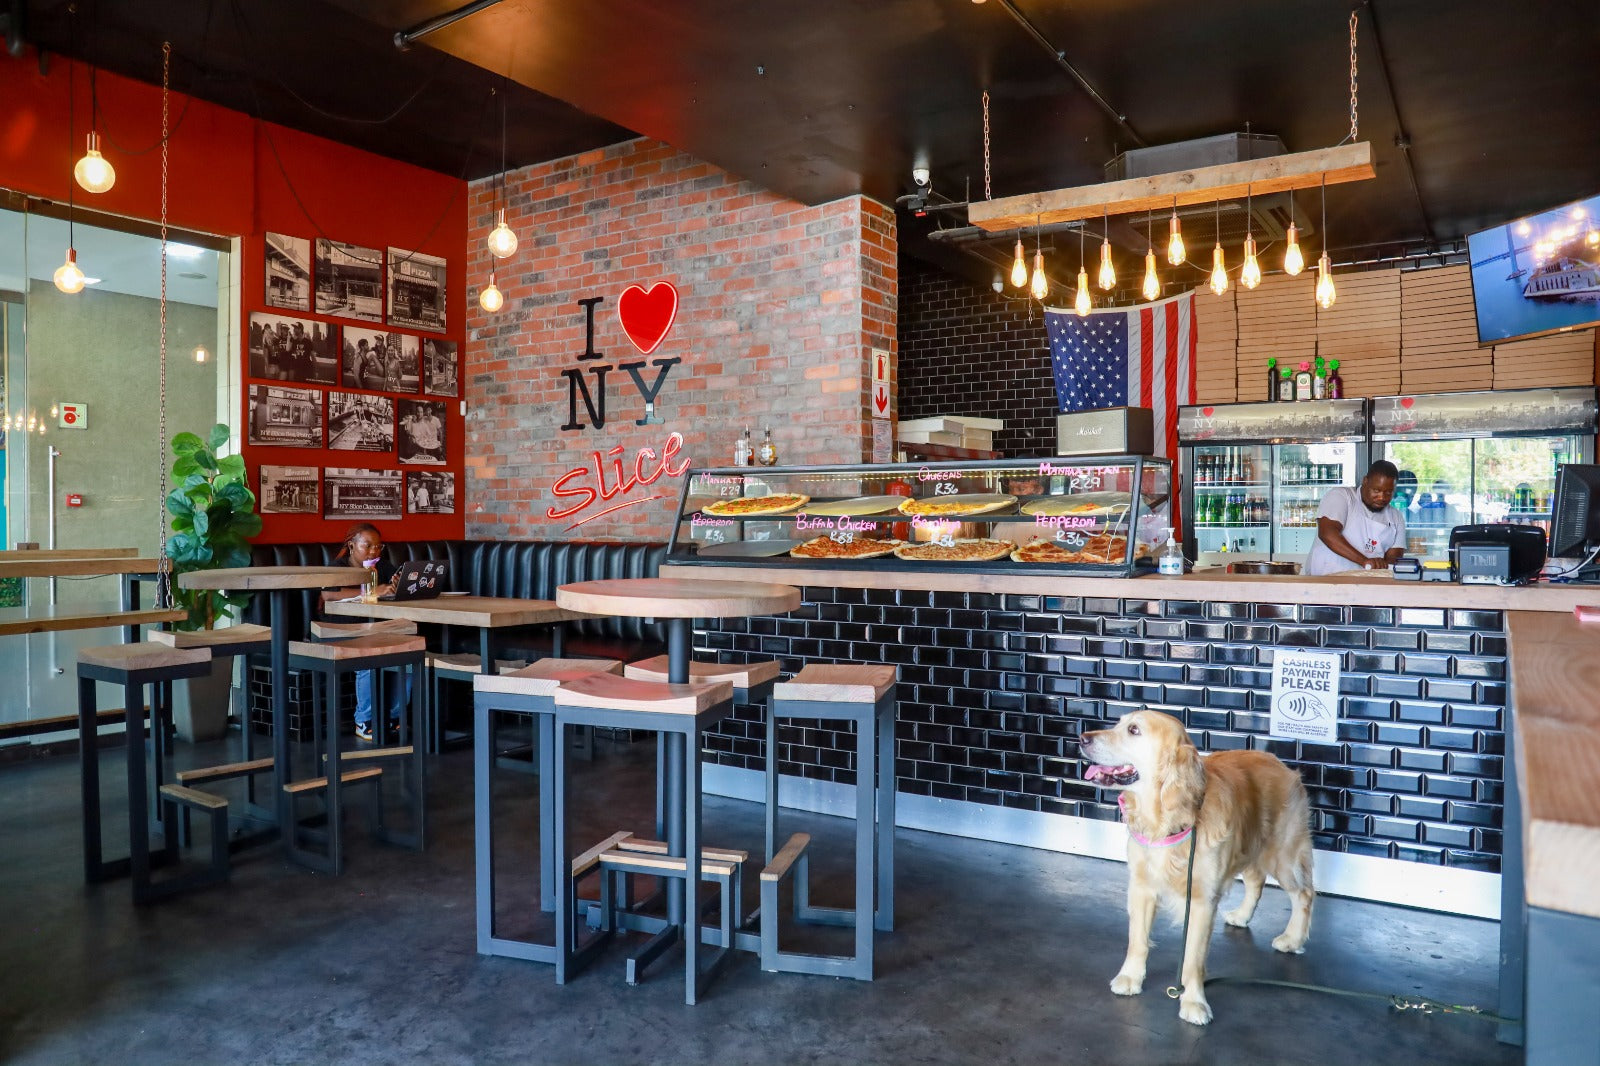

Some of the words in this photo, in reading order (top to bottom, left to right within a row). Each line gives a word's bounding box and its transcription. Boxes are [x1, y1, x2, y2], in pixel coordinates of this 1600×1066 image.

[411, 265, 432, 278] PIZZA
[577, 296, 604, 361] I
[286, 392, 306, 400] PIZZA
[560, 356, 682, 431] NY
[1391, 409, 1416, 421] NY
[1192, 418, 1216, 429] NY
[935, 482, 959, 495] R36
[1070, 476, 1100, 490] R29
[720, 485, 740, 496] R29
[705, 529, 725, 542] R36
[830, 530, 854, 544] R38
[930, 534, 956, 547] R36
[1055, 530, 1085, 546] R36
[1282, 658, 1332, 670] CASHLESS
[1281, 667, 1331, 680] PAYMENT
[1280, 676, 1331, 692] PLEASE
